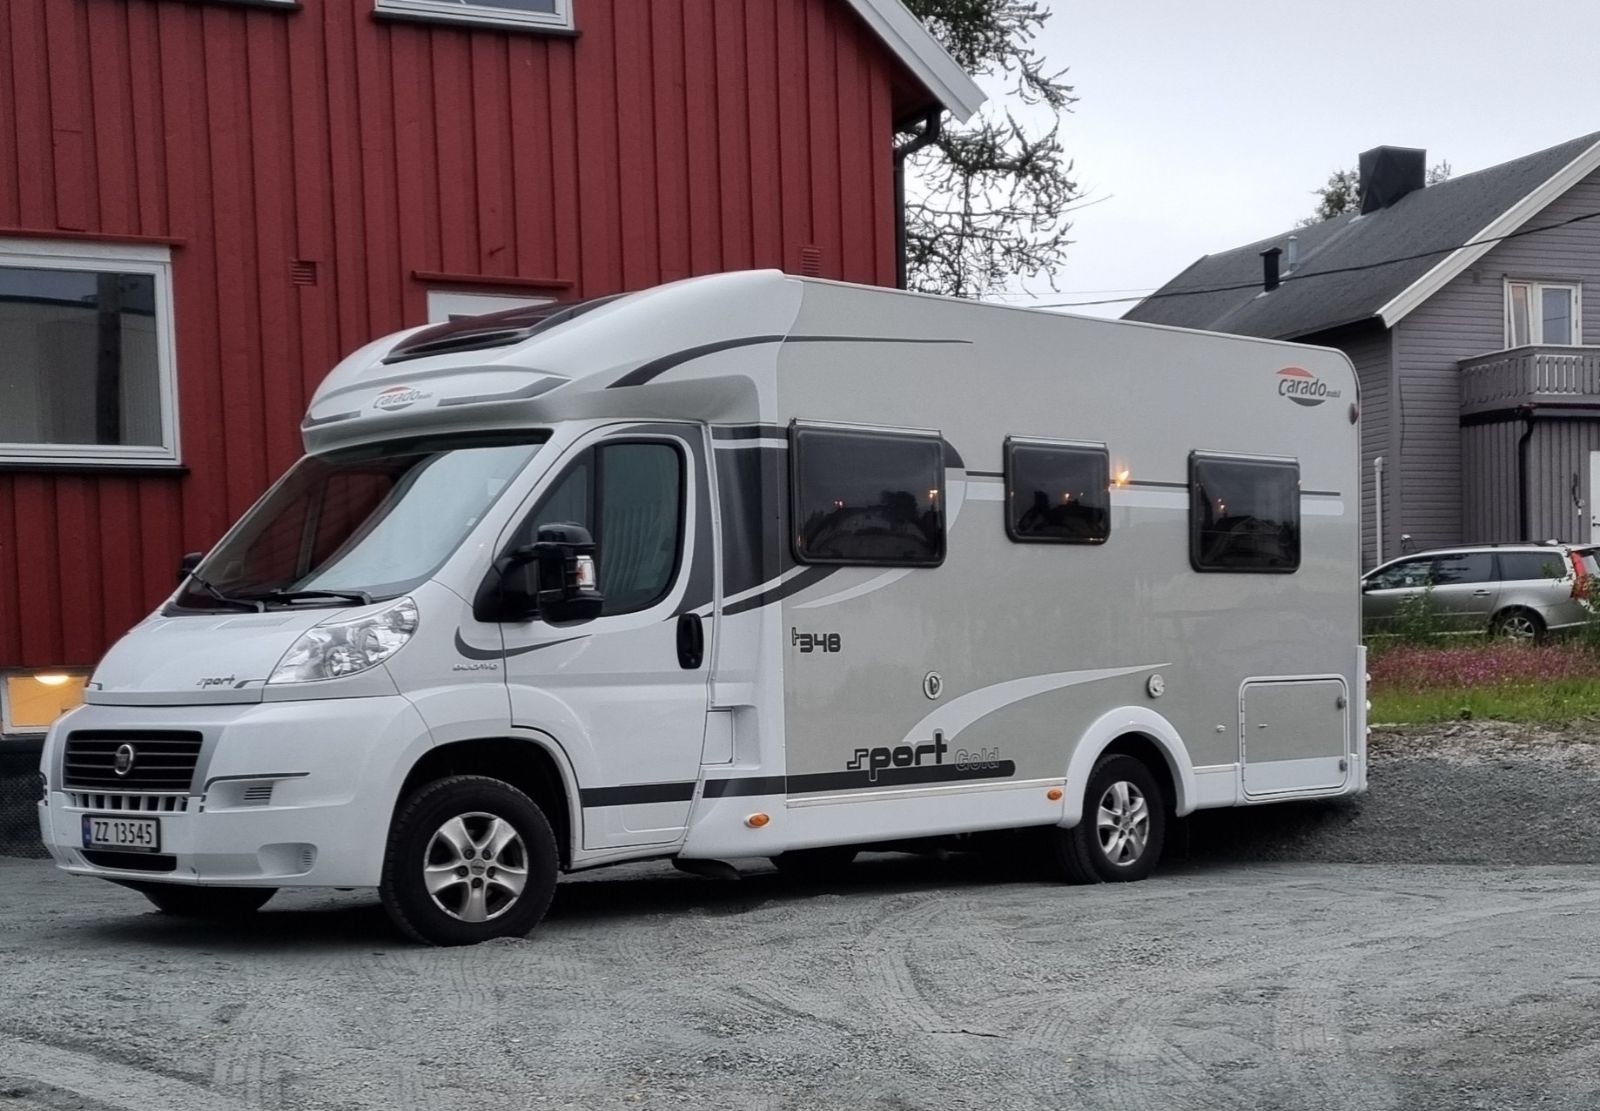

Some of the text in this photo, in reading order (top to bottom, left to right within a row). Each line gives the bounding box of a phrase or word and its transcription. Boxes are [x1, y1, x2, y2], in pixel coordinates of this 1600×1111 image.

[1278, 377, 1327, 397] Carado
[954, 747, 1000, 772] Gold
[94, 821, 152, 844] ZZ 13545
